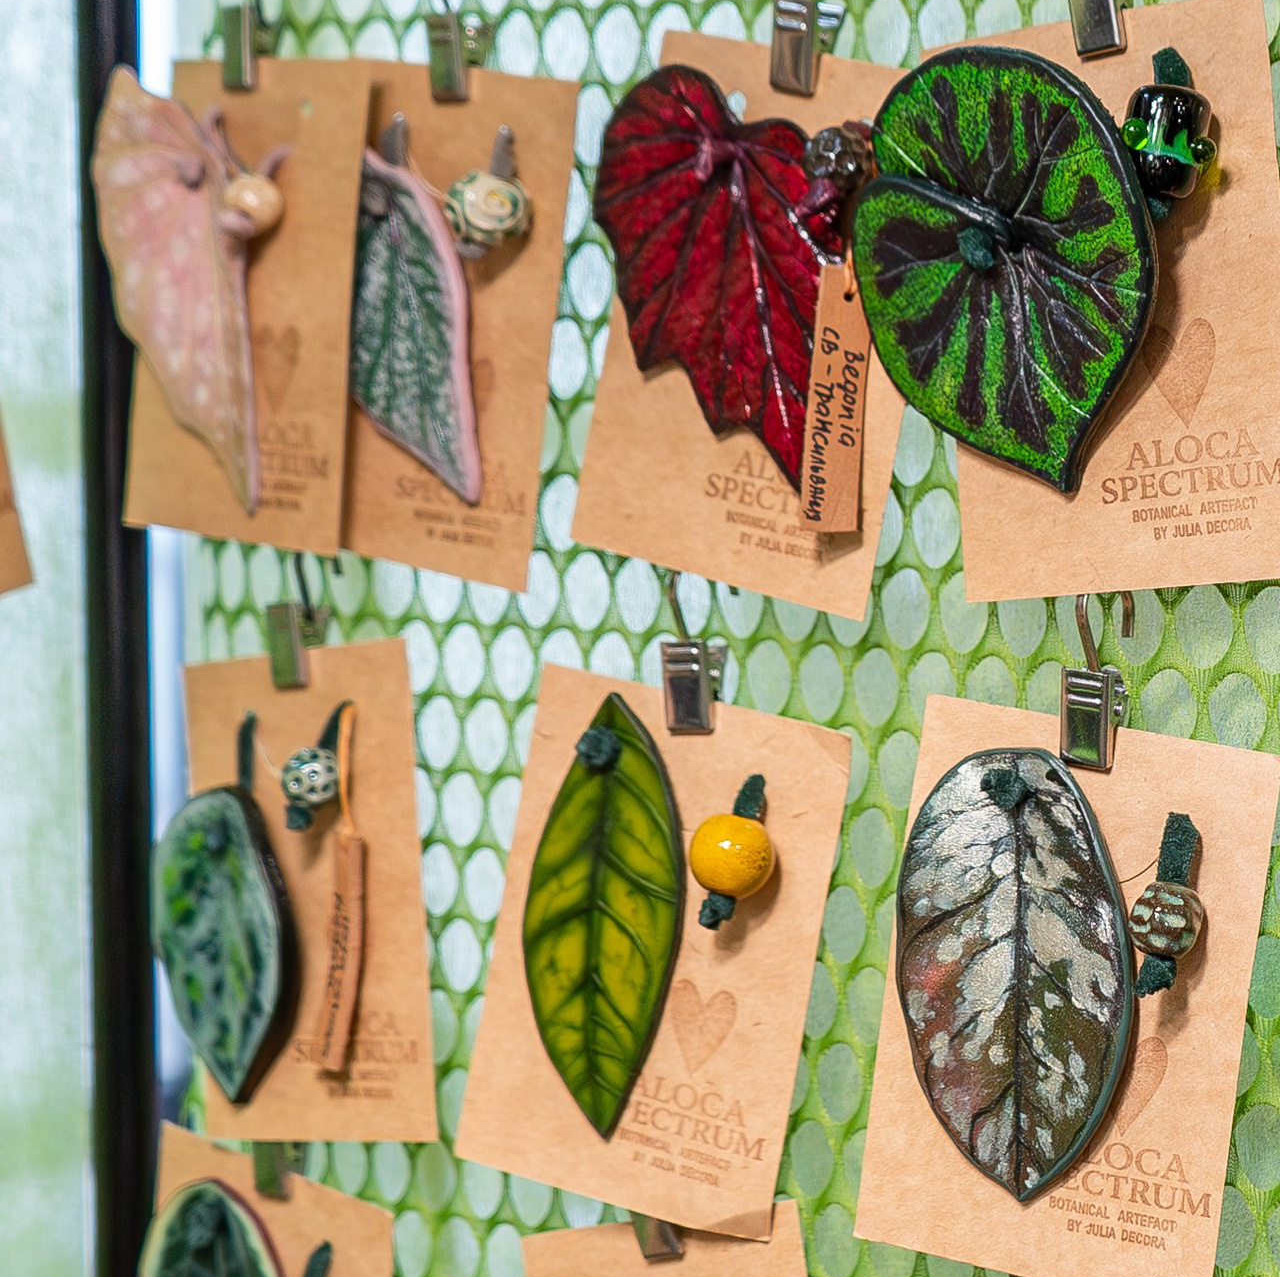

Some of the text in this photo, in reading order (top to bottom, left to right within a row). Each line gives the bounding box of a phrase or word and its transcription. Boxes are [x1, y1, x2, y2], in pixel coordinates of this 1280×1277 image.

[1126, 428, 1260, 470] ALOCA
[706, 473, 796, 514] SPECT
[1132, 504, 1193, 522] BOTANICAL
[1154, 517, 1252, 541] BY JULIA DECORA
[632, 1100, 766, 1161] ECTRUM
[1049, 1195, 1110, 1219] BOTANICAL
[1061, 1168, 1212, 1218] ECTRUM
[1068, 1219, 1166, 1250] BY JULIA DECORA
